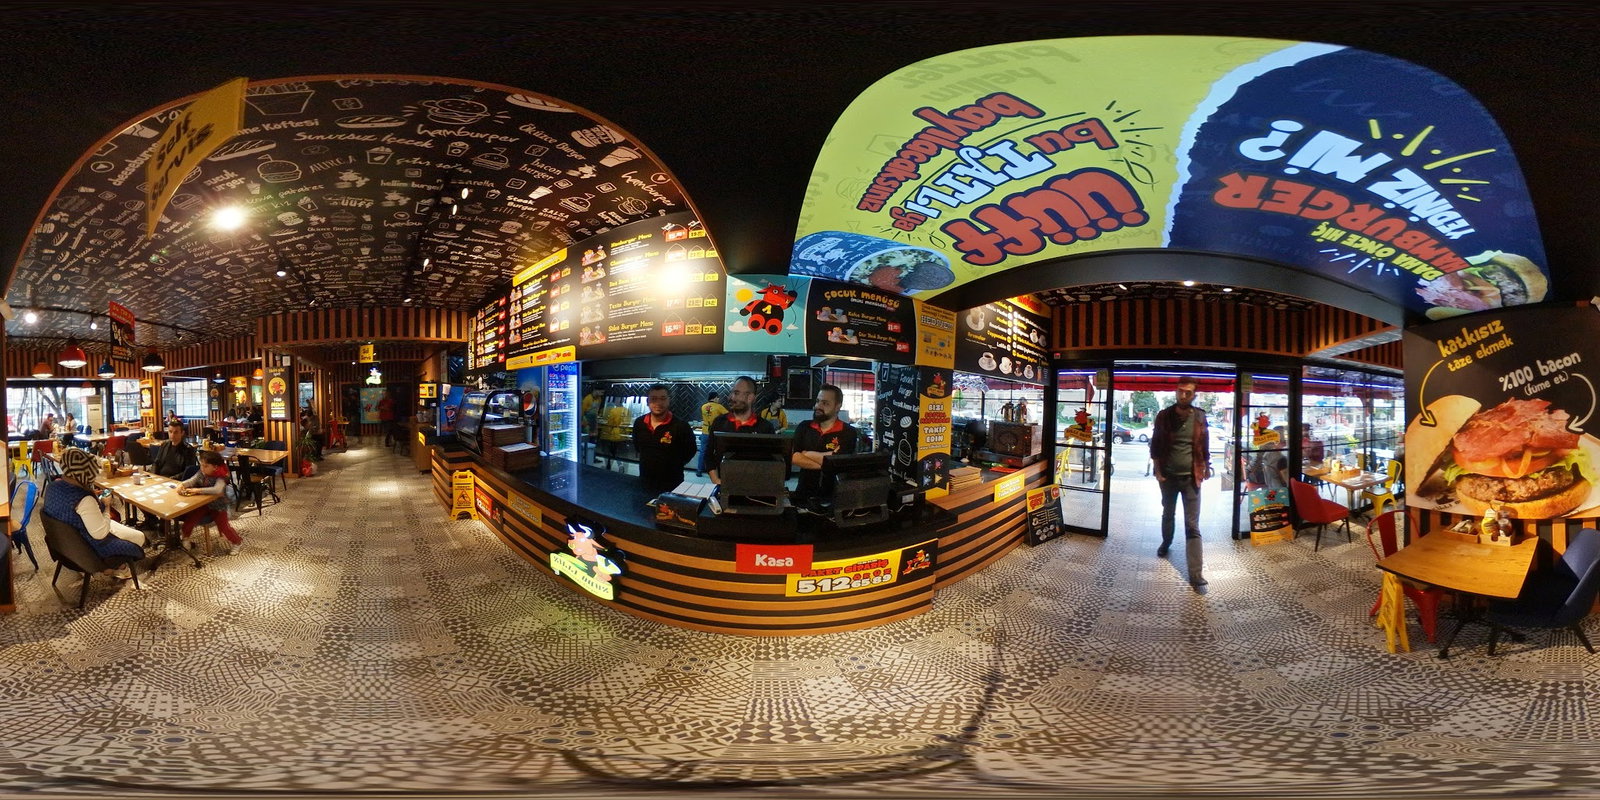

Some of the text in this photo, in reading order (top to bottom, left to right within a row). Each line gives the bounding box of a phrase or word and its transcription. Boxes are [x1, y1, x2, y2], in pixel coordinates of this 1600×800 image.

[416, 123, 521, 145] hamburger
[857, 92, 1045, 212] bayılacaksınız
[1025, 118, 1119, 155] bu
[1239, 119, 1394, 185] Mİ?
[519, 163, 555, 181] burger
[530, 158, 562, 177] bacon
[940, 167, 1150, 265] üüff
[1213, 172, 1470, 274] HAMBURGER
[1366, 167, 1476, 241] YEDİNİZ
[1342, 232, 1391, 260] ÖNCE
[1391, 254, 1444, 281] DAHA
[1437, 319, 1505, 358] katkısız
[1447, 333, 1514, 373] taze ekmek
[1498, 352, 1582, 392] %100 bacon
[755, 553, 793, 567] Kasa
[797, 576, 852, 594] 512
